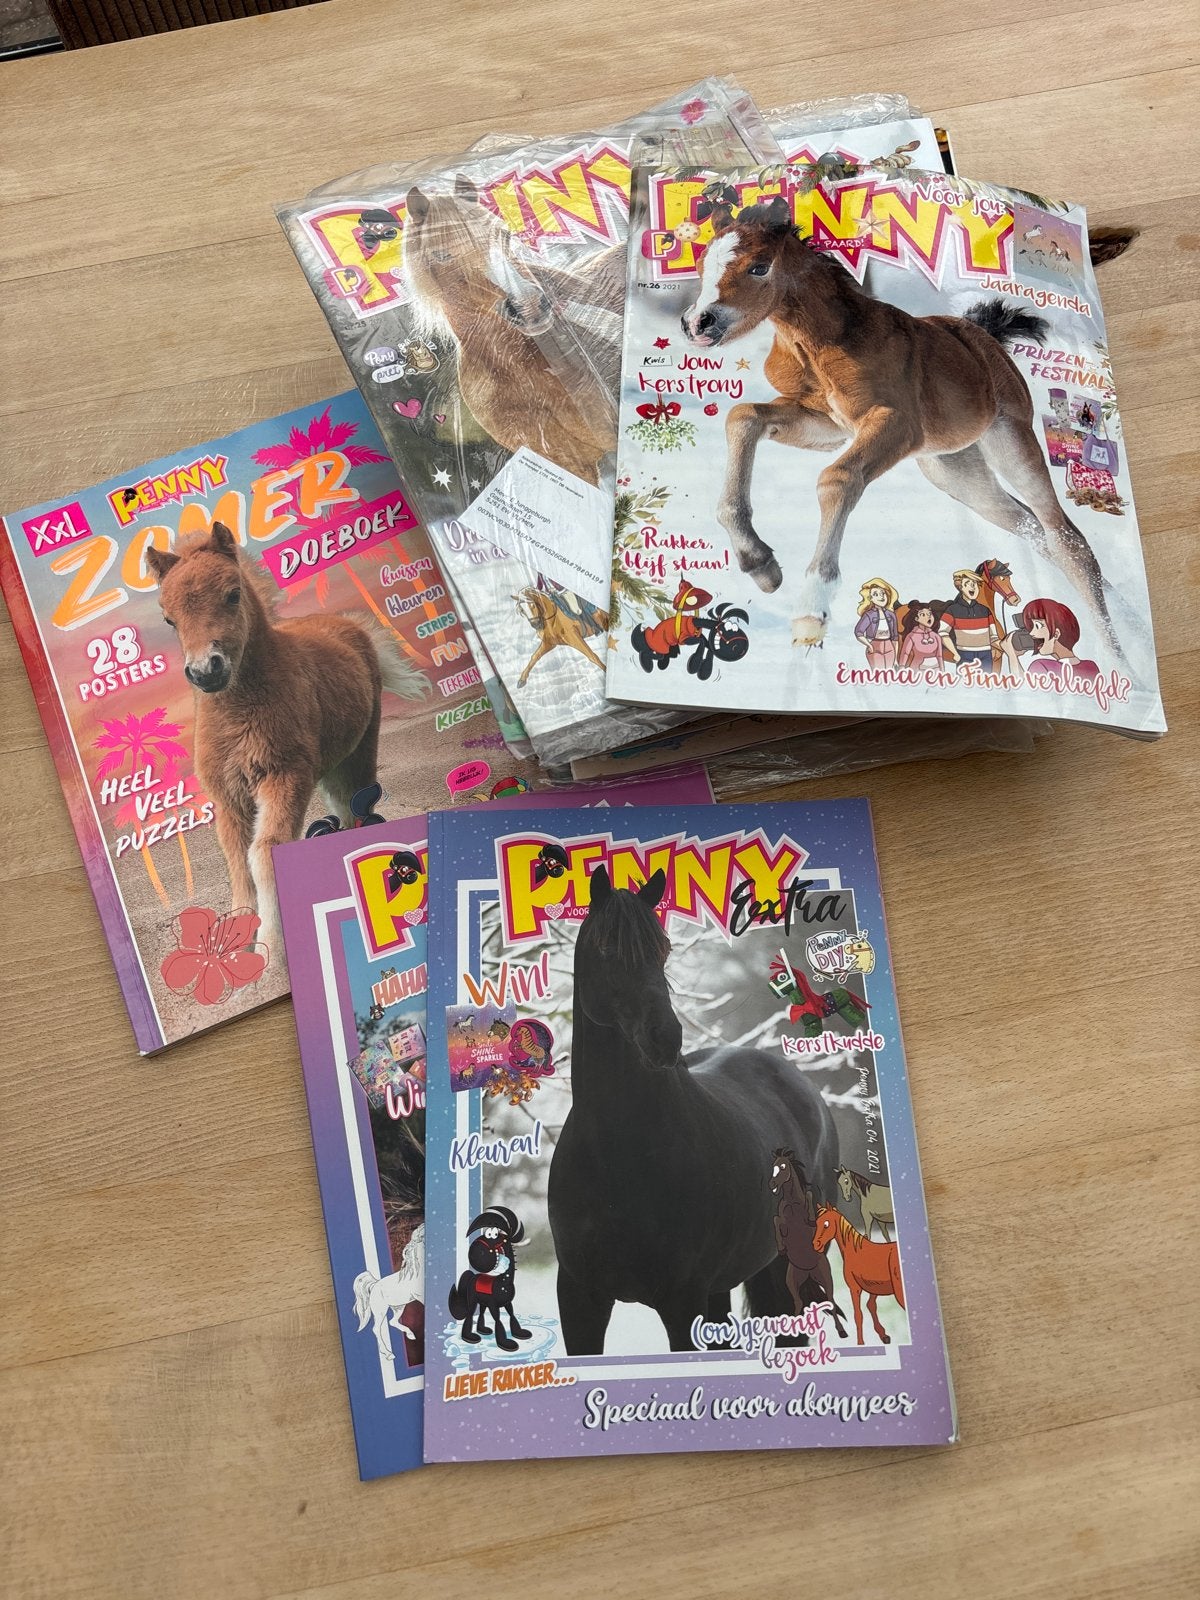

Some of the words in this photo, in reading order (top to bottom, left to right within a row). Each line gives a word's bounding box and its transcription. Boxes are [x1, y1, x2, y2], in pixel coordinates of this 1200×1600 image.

[915, 183, 964, 207] Voor
[972, 199, 1005, 216] jou:
[823, 238, 865, 249] PAARD!
[637, 282, 661, 290] nr.26
[981, 275, 1091, 317] Jaaragenda
[364, 351, 395, 367] Pony
[376, 367, 401, 382] pret
[642, 355, 666, 366] Kwis
[677, 353, 724, 371] Jouw
[1030, 362, 1108, 391] FESTIVAL
[107, 455, 229, 528] PENNY
[50, 449, 361, 631] ZOMER
[278, 501, 409, 580] DOEBOEK
[640, 526, 714, 551] Rakker,
[381, 557, 432, 586] kwissen
[468, 548, 489, 564] in
[624, 550, 667, 578] blijf
[672, 550, 730, 572] staan!
[387, 585, 444, 616] kleuren
[417, 613, 456, 638] STRIPS
[86, 626, 141, 676] 28
[431, 638, 468, 666] FUN
[78, 655, 167, 701] POSTERS
[438, 668, 480, 696] TEKENEN
[836, 662, 920, 685] Emma
[926, 670, 957, 687] en
[959, 661, 1022, 689] Finn
[1026, 661, 1131, 712] verliefd?
[100, 764, 161, 805] HEEL
[135, 781, 193, 820] VEEL
[116, 801, 214, 857] PUZZELS
[496, 829, 807, 944] PENNY
[730, 876, 847, 937] Extra
[815, 945, 845, 970] DIY
[464, 952, 553, 1008] Win!
[471, 1047, 496, 1058] SHINE
[476, 1053, 504, 1063] SPARKLE
[451, 1121, 541, 1171] Kleuren!
[866, 1129, 878, 1143] 04
[867, 1149, 880, 1174] 2021
[691, 1302, 833, 1353] (on)gewenst
[761, 1330, 838, 1381] bezoek
[445, 1371, 488, 1399] LIEVE
[491, 1362, 575, 1392] RAKKER...
[582, 1386, 706, 1431] Speciaal
[711, 1395, 781, 1420] voor
[786, 1381, 917, 1423] abonnees
